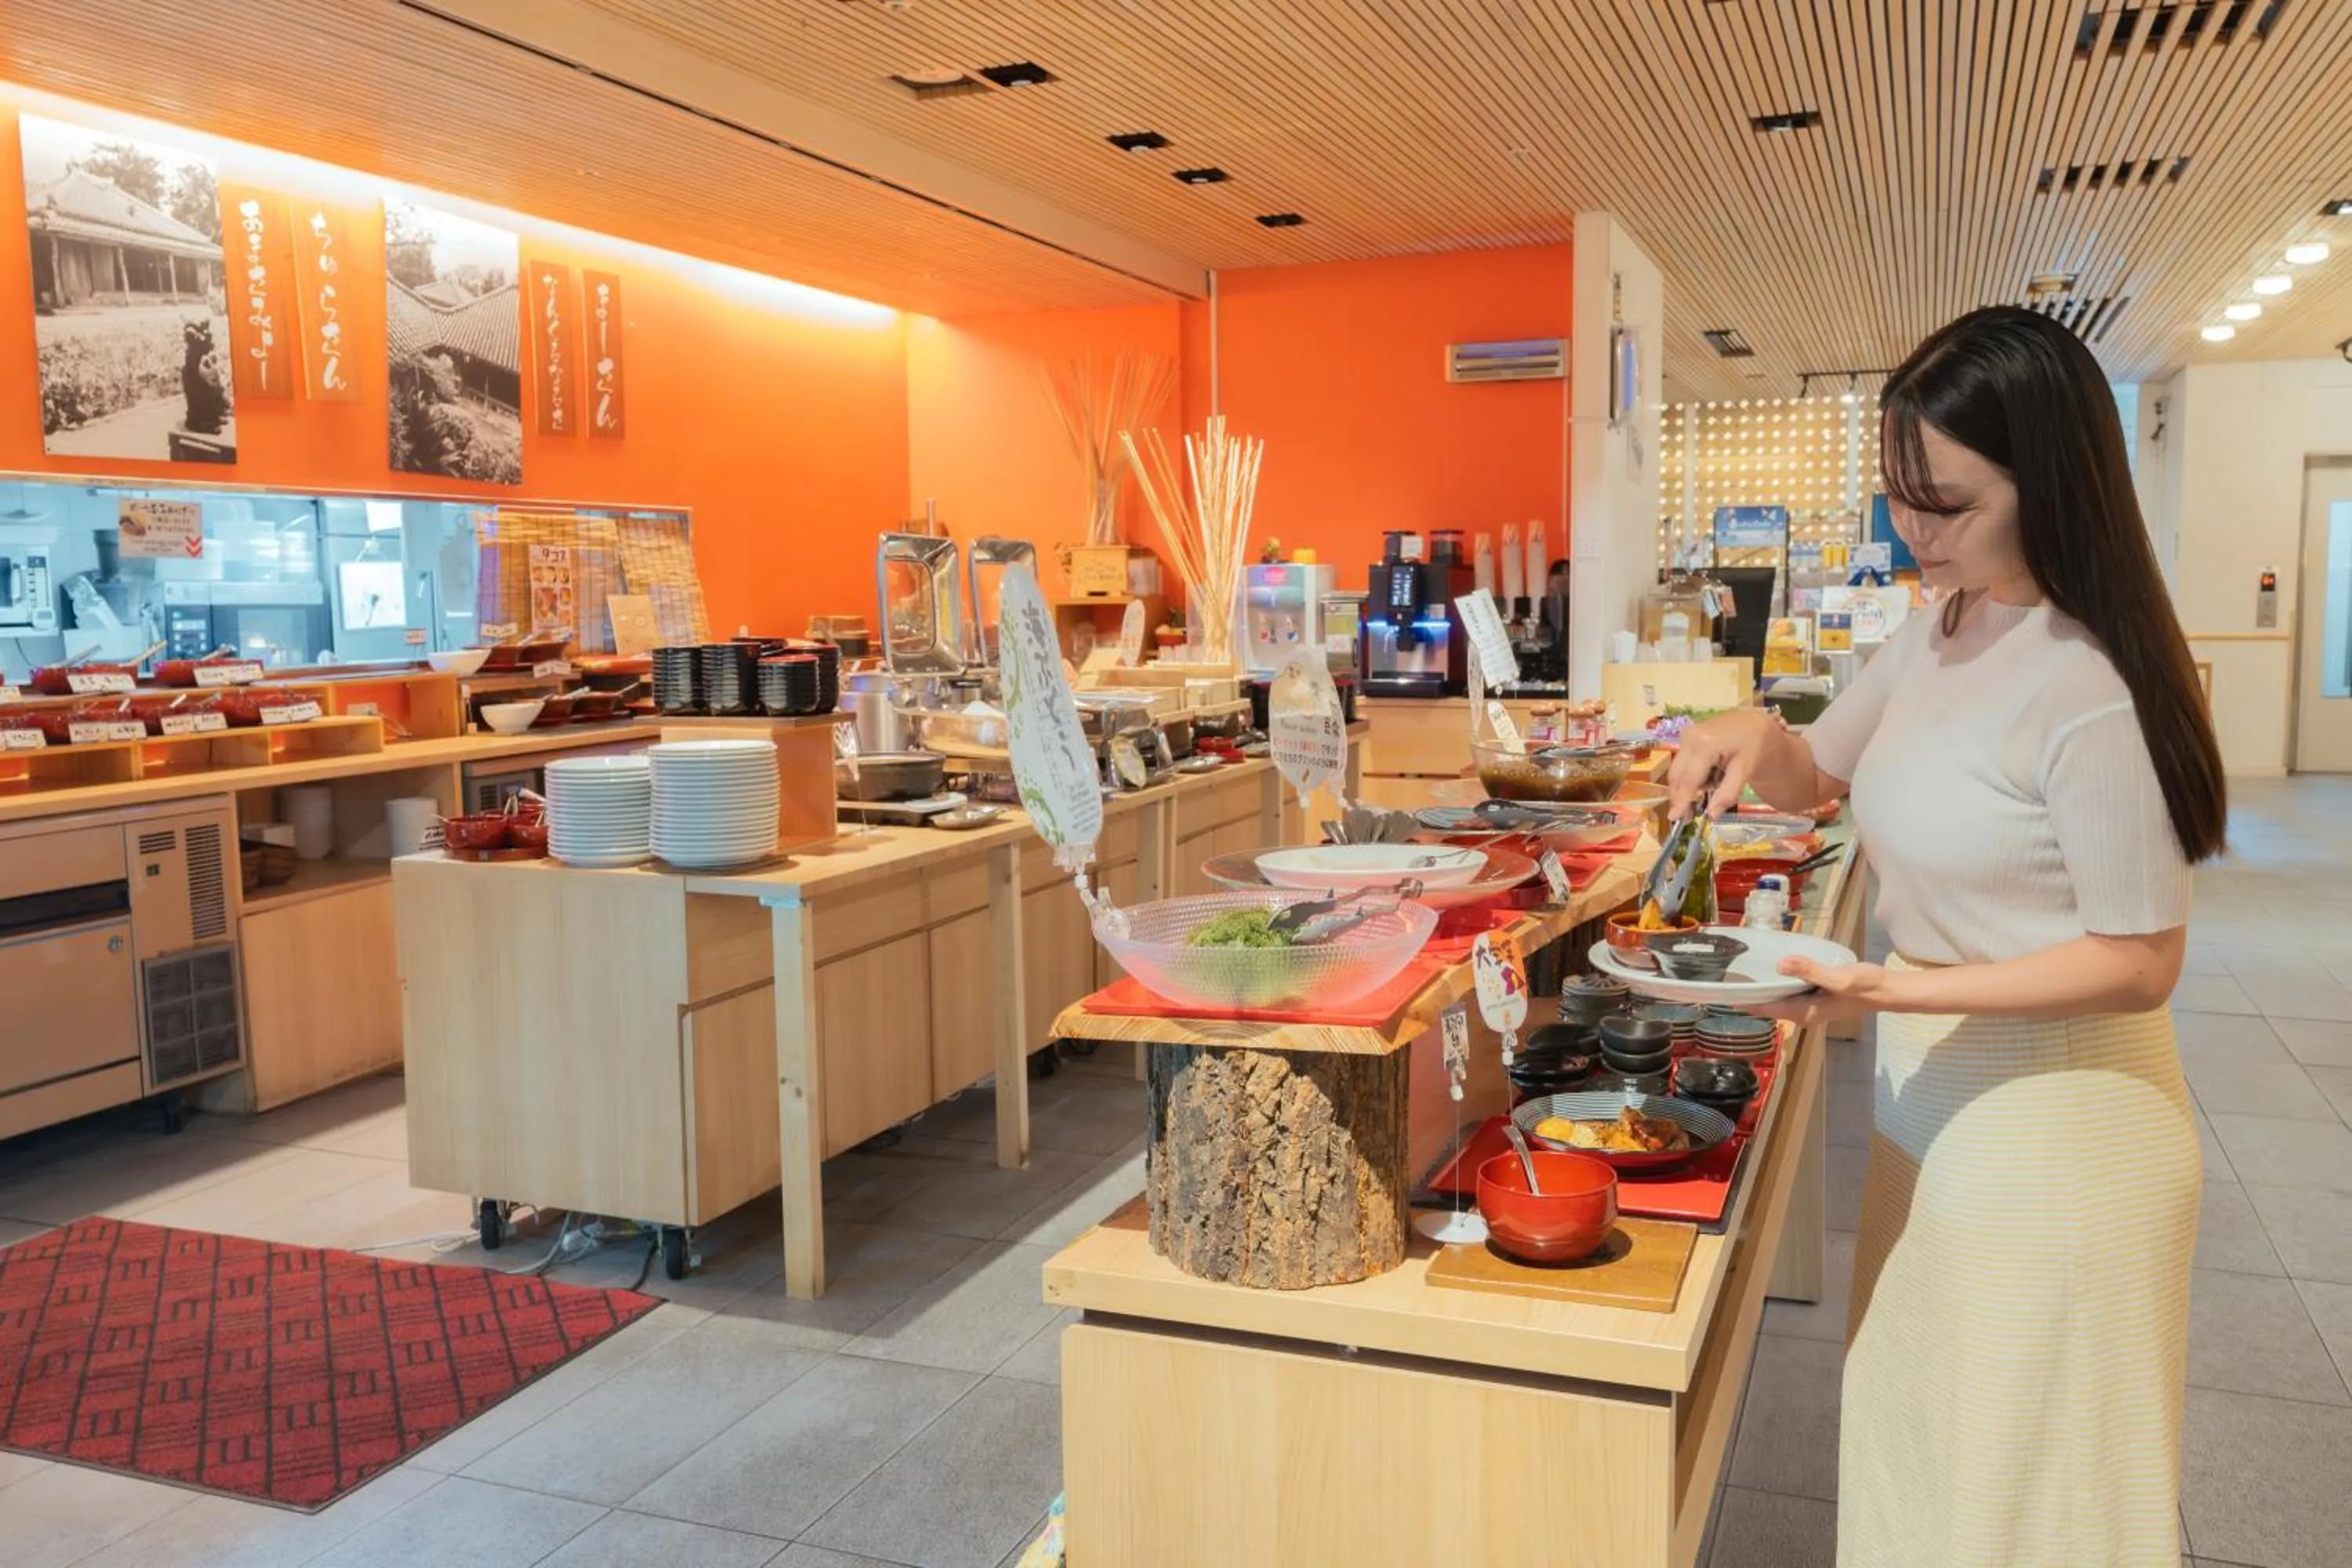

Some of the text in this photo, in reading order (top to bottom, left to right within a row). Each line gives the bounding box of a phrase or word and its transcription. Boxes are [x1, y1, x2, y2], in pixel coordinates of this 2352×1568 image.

[310, 211, 347, 391] ちゅらさん
[542, 547, 567, 563] タコス
